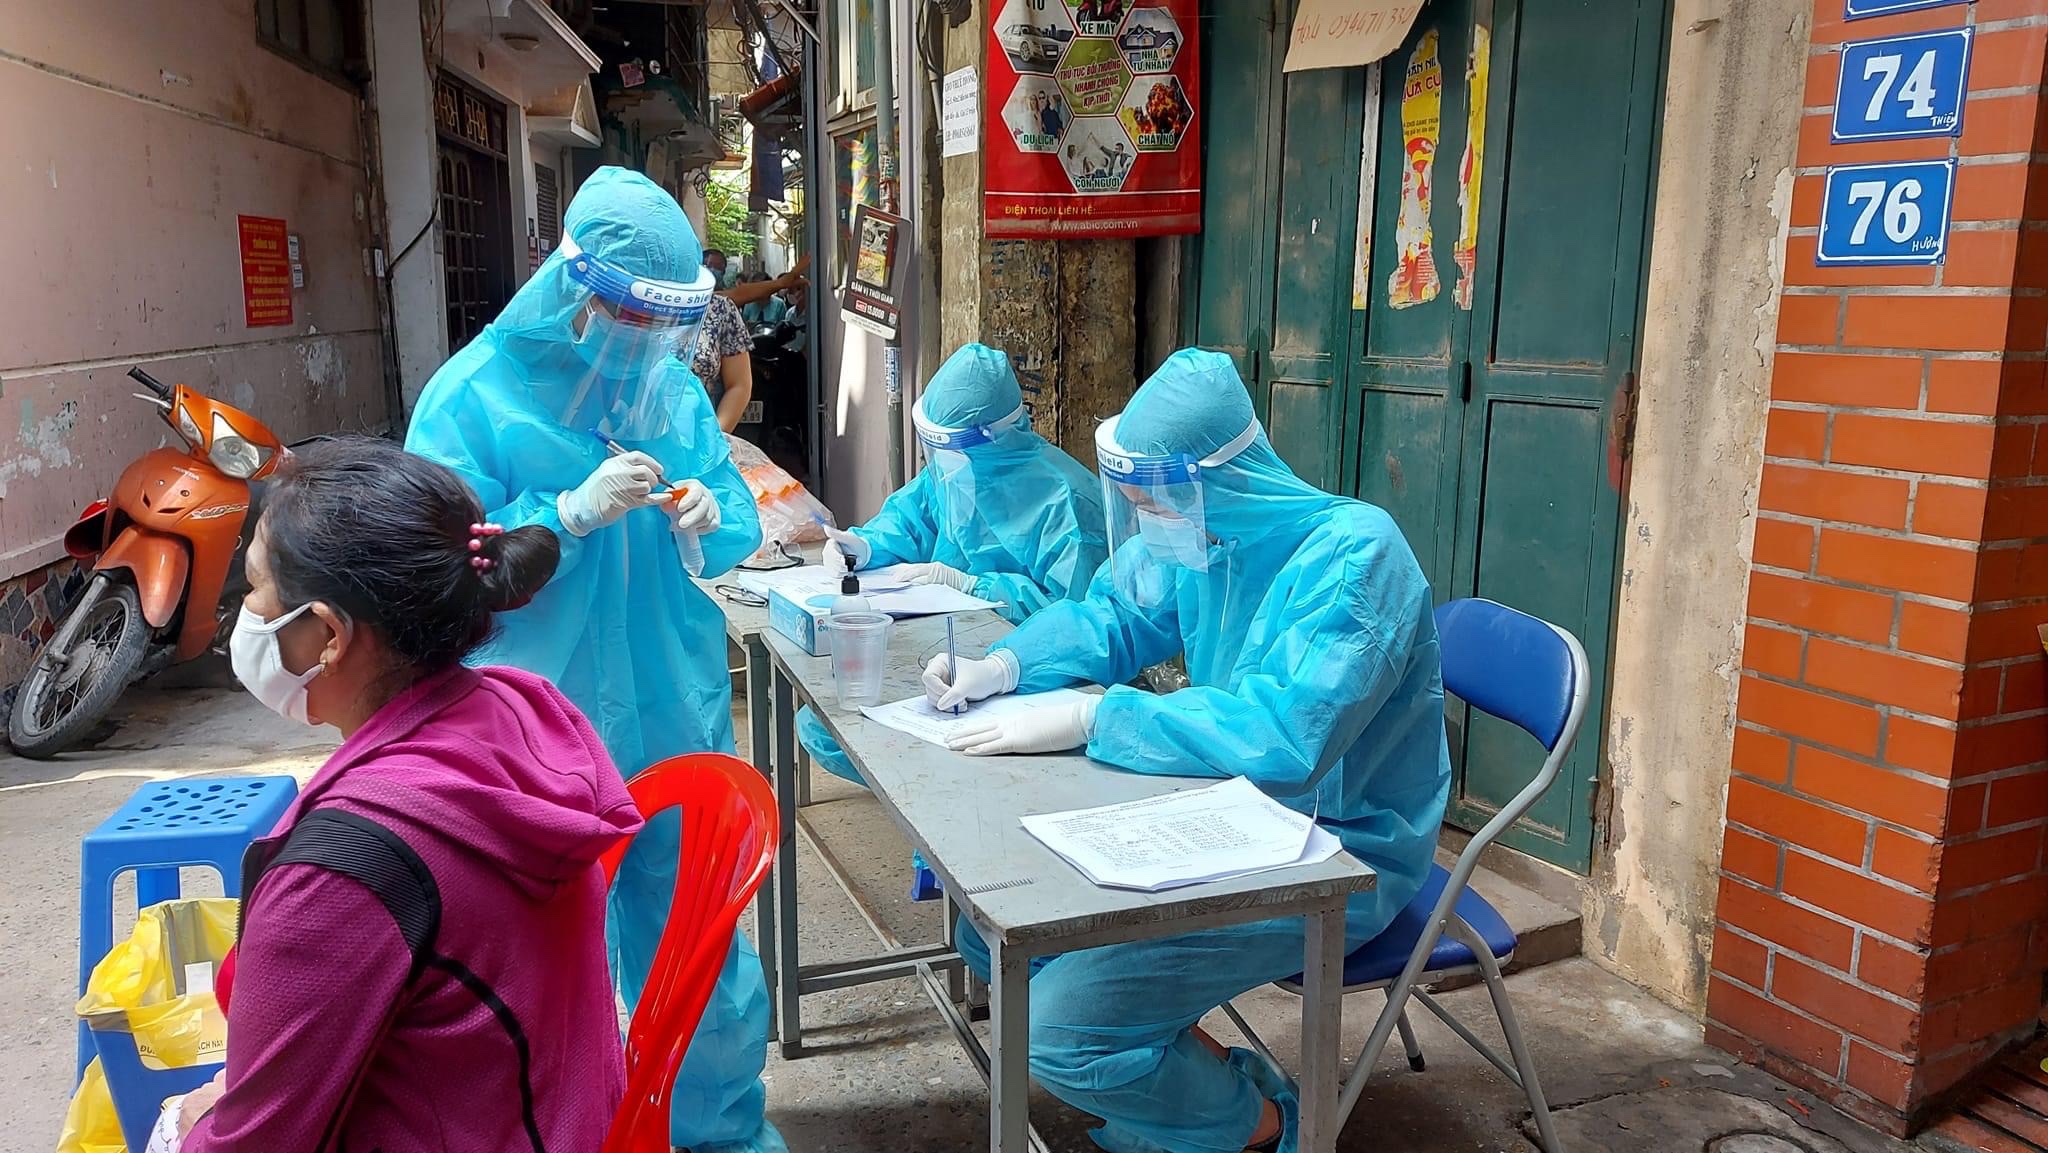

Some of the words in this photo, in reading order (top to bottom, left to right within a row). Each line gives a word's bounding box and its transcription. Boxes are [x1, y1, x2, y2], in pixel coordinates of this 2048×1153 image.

[1080, 22, 1095, 35] XE
[1863, 50, 1936, 121] 74
[1023, 135, 1036, 145] DU
[1848, 179, 1922, 245] 76
[644, 287, 681, 304] Face
